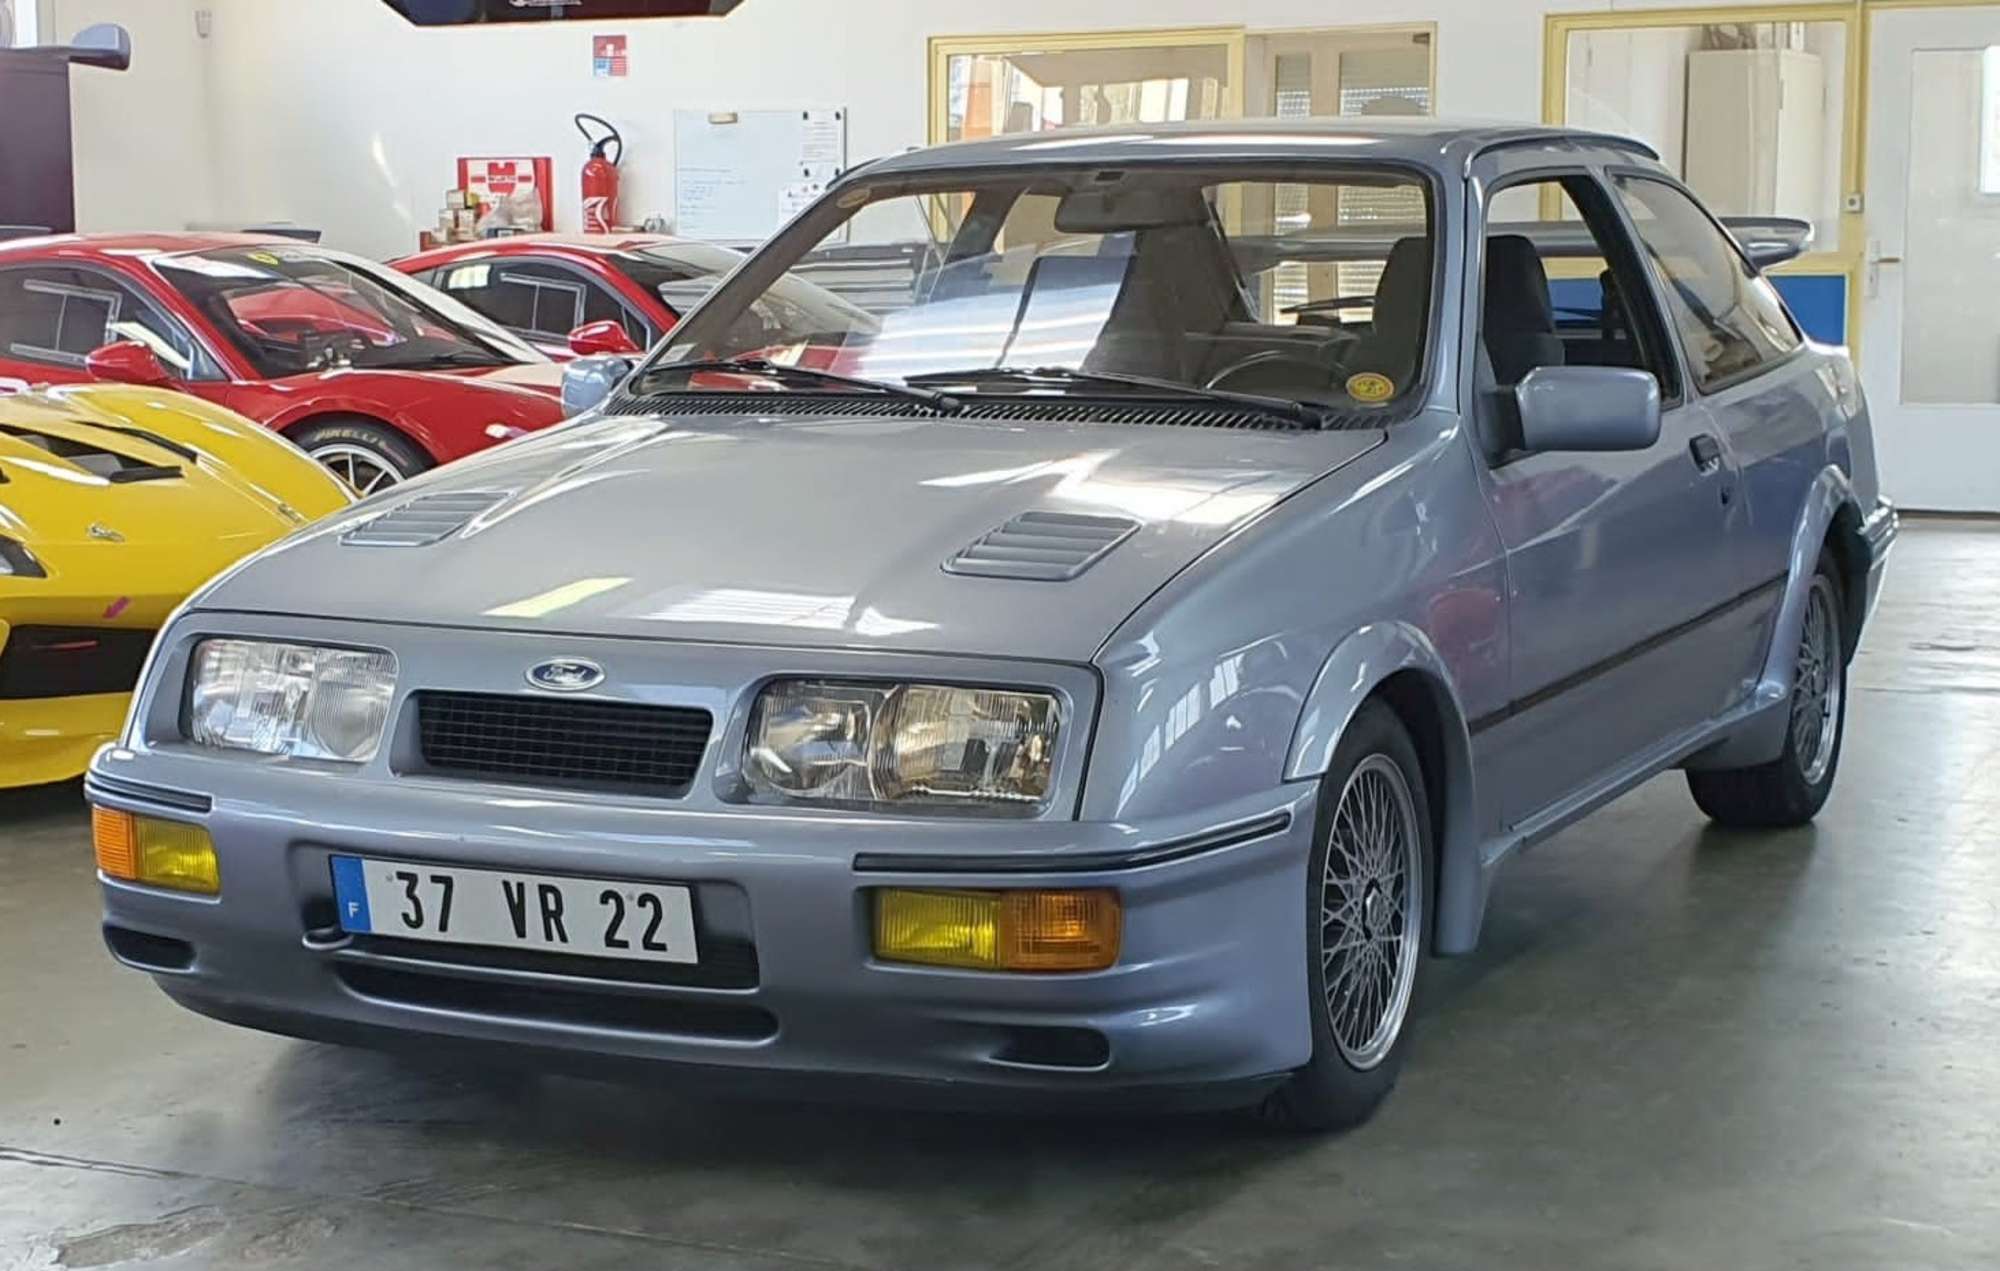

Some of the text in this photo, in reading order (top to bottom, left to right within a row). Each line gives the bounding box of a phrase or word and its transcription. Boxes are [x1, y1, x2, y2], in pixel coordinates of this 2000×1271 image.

[348, 902, 360, 918] F
[396, 871, 668, 952] 37 VR 22
